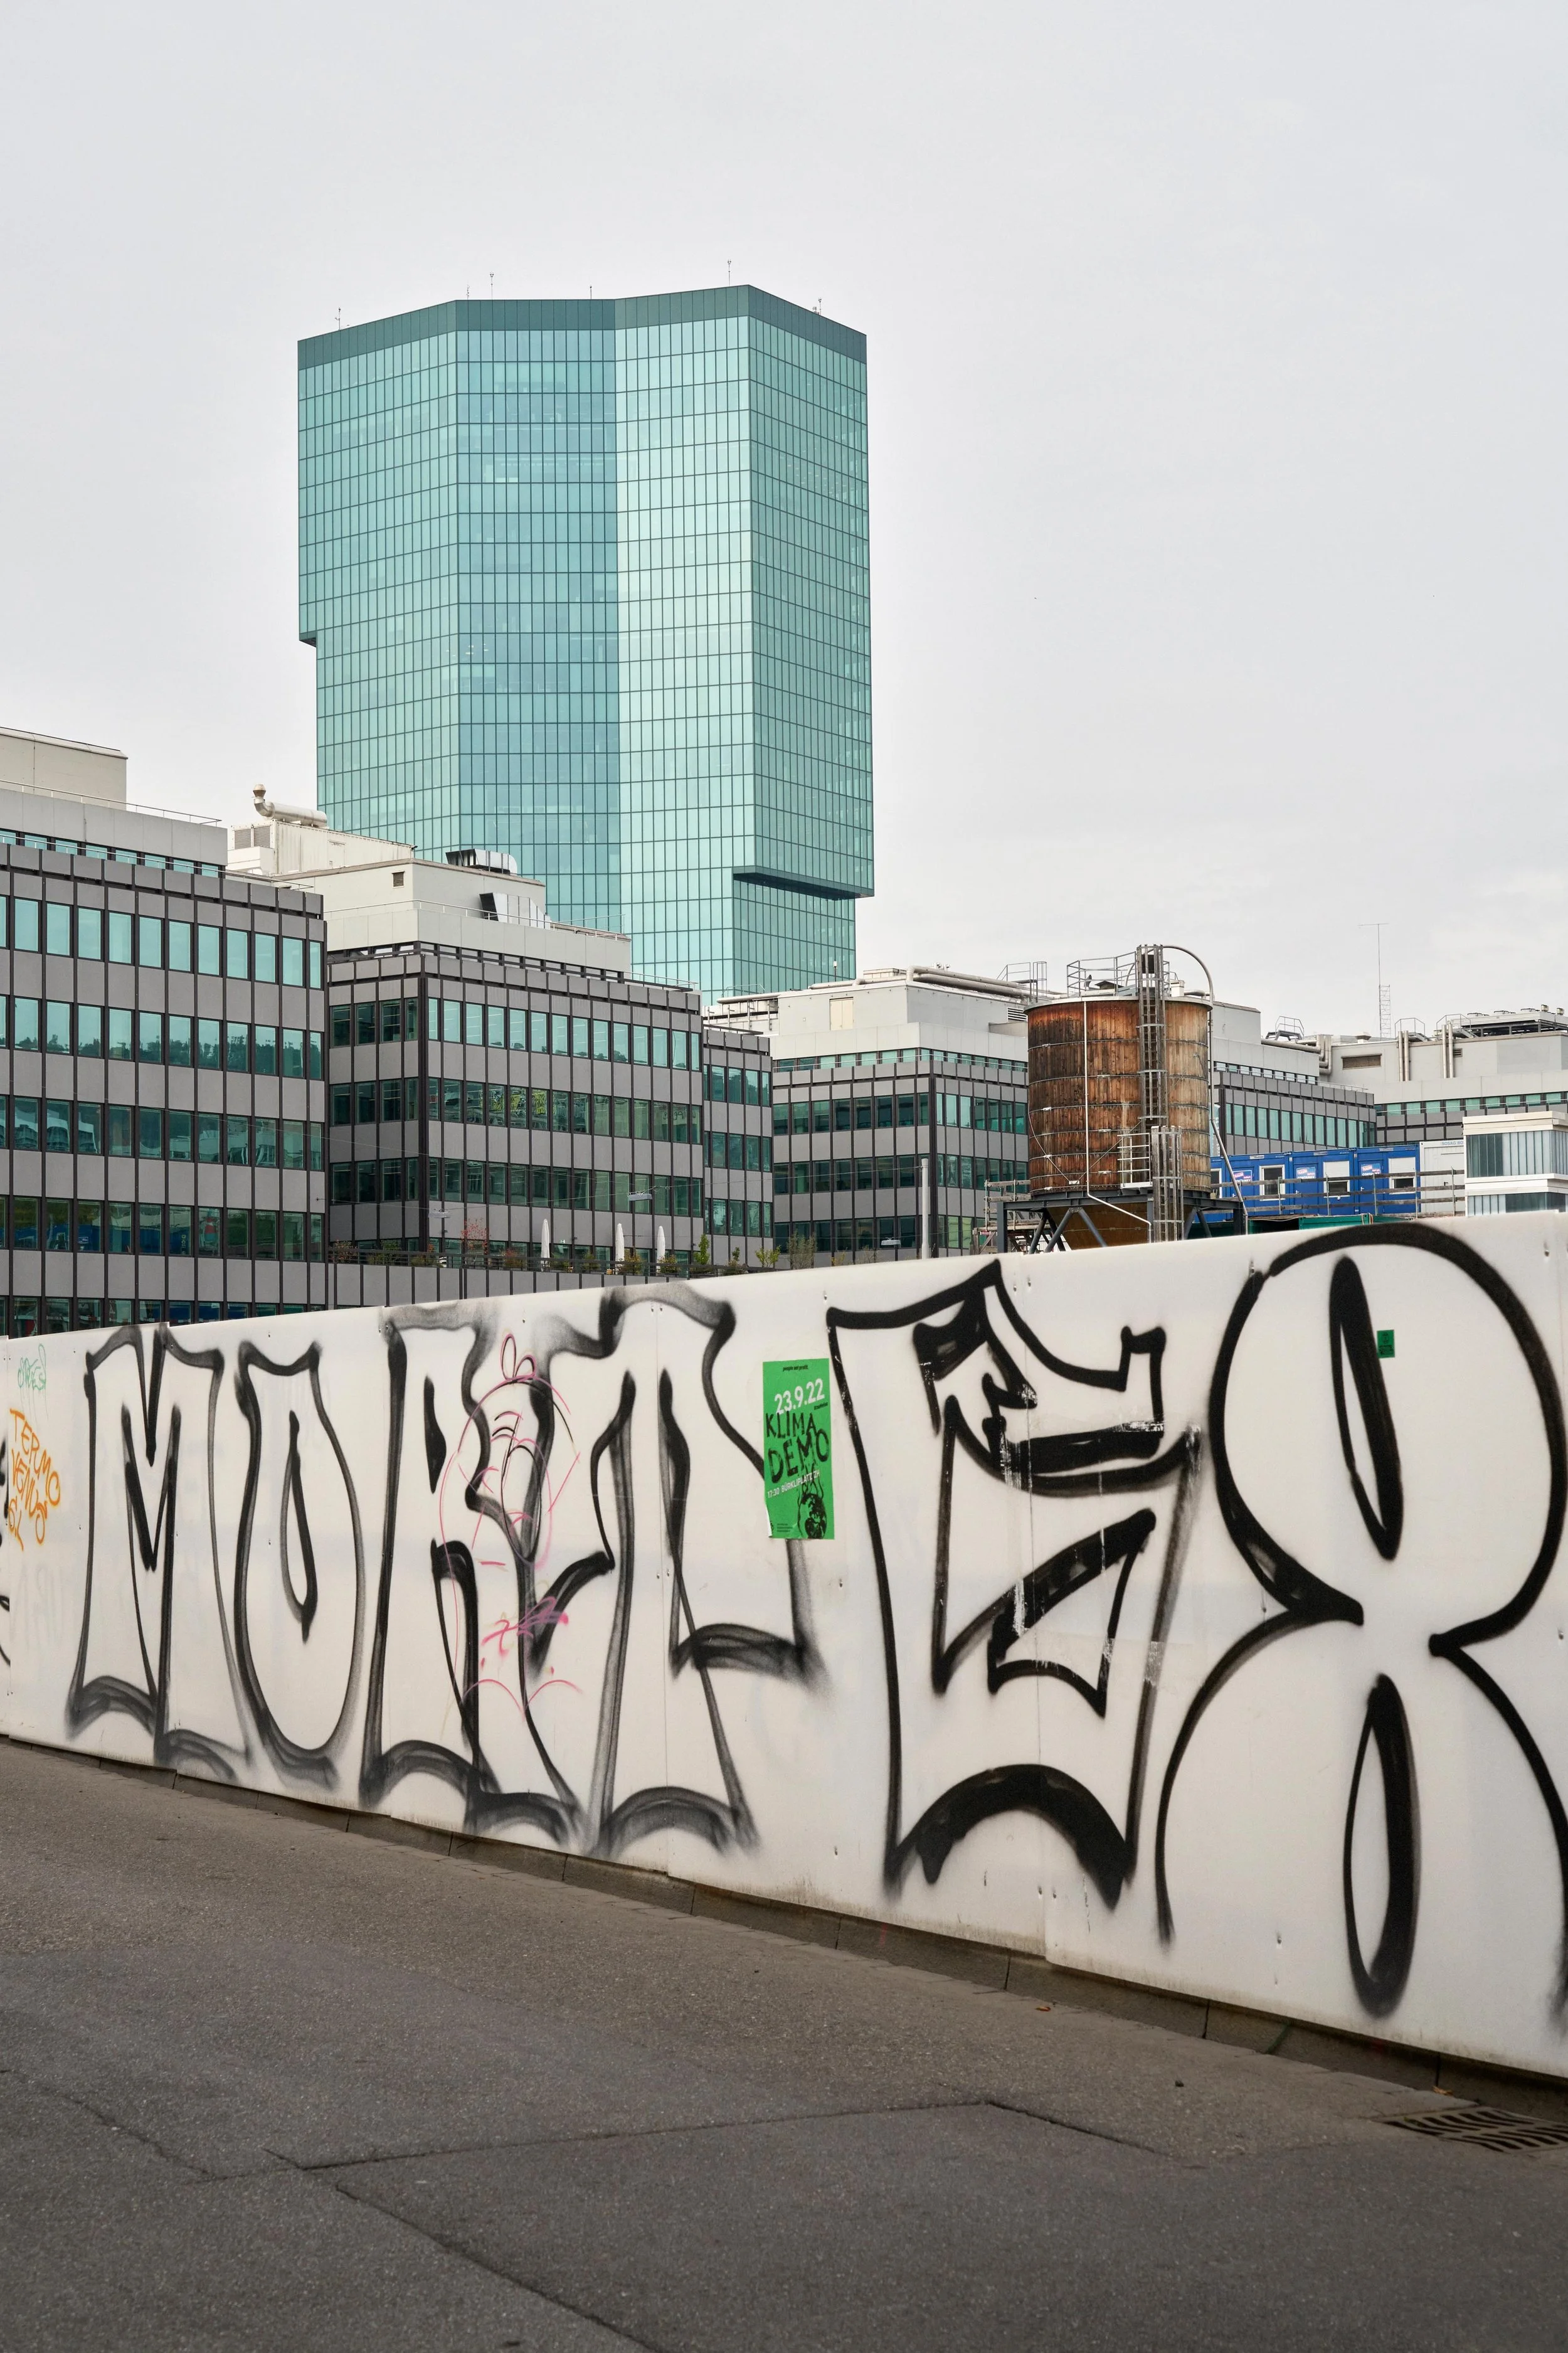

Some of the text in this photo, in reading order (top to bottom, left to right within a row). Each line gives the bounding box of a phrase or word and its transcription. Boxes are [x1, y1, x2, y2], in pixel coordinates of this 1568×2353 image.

[775, 1378, 825, 1415] 23.9.22
[765, 1411, 817, 1439] KLIMA
[768, 1428, 829, 1484] DEMO
[767, 1487, 780, 1499] 17:30
[781, 1473, 813, 1493] BÜRKLIPLATZ
